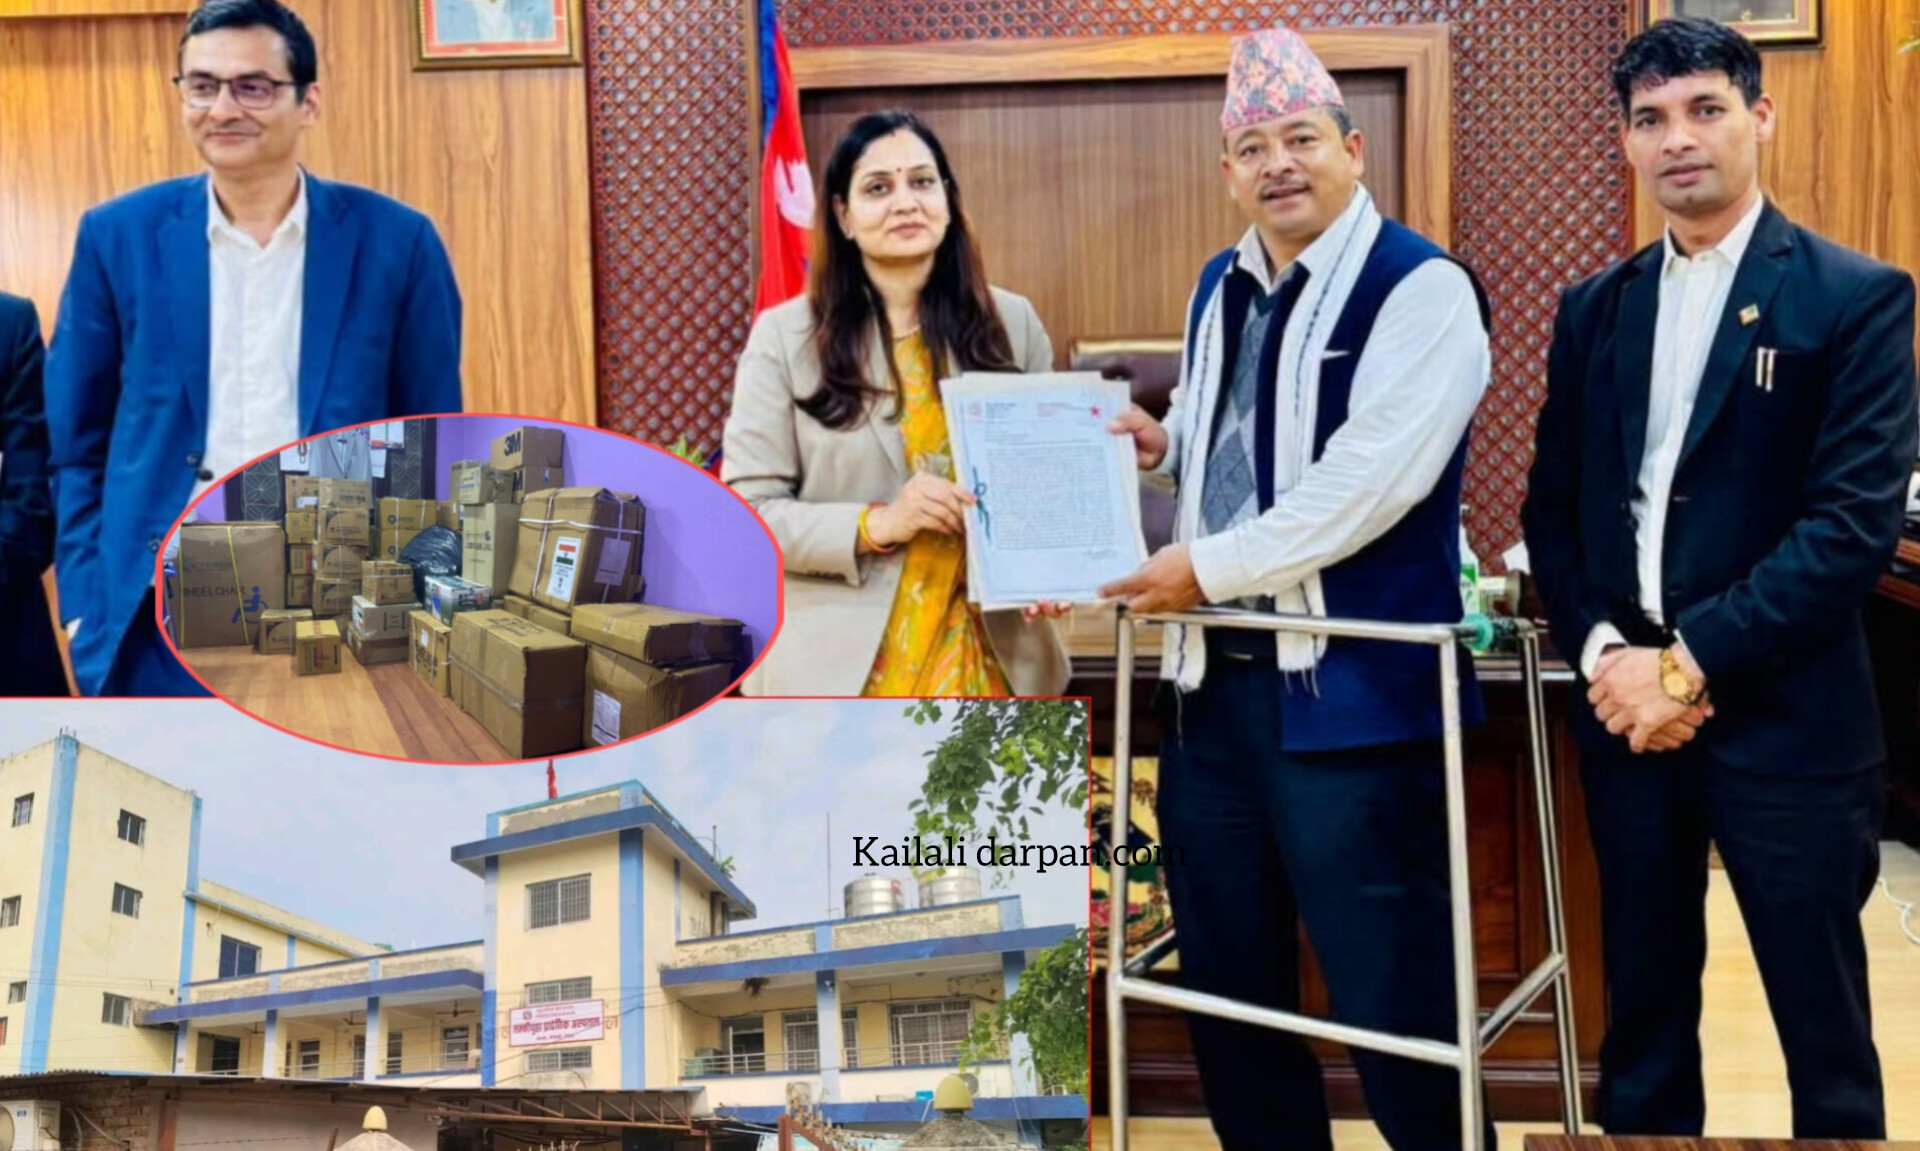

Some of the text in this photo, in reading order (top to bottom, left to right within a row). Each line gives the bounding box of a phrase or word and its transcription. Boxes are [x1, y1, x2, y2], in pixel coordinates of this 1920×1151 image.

[504, 431, 521, 457] 3M
[513, 469, 523, 492] M
[183, 585, 245, 598] HEELCHAR
[571, 1017, 600, 1029] अस्पताल
